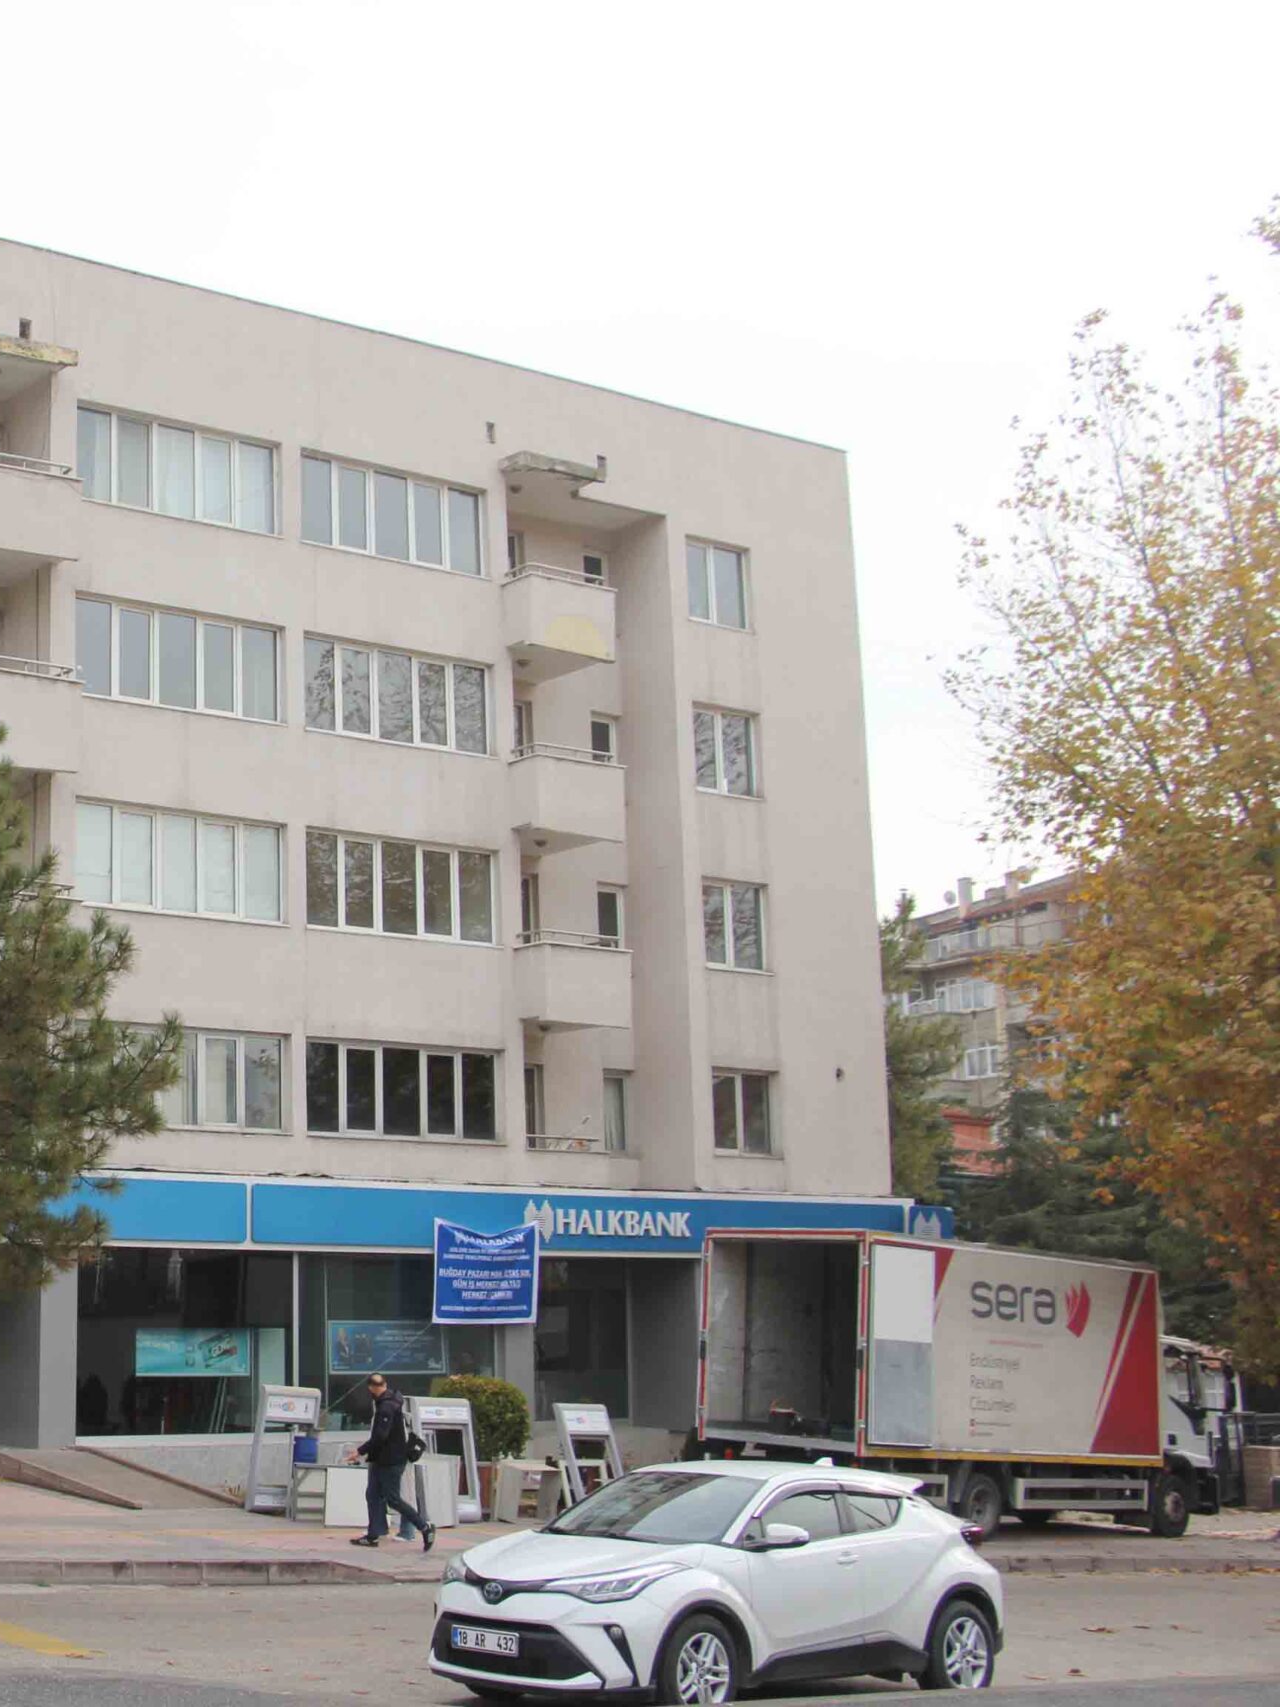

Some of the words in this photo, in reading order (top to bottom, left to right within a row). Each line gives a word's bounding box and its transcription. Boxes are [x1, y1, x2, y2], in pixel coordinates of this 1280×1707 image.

[556, 1208, 692, 1238] HALKBANK
[971, 1281, 1056, 1325] sera
[459, 1630, 468, 1645] 18
[475, 1633, 486, 1648] AR
[496, 1636, 514, 1652] 432
